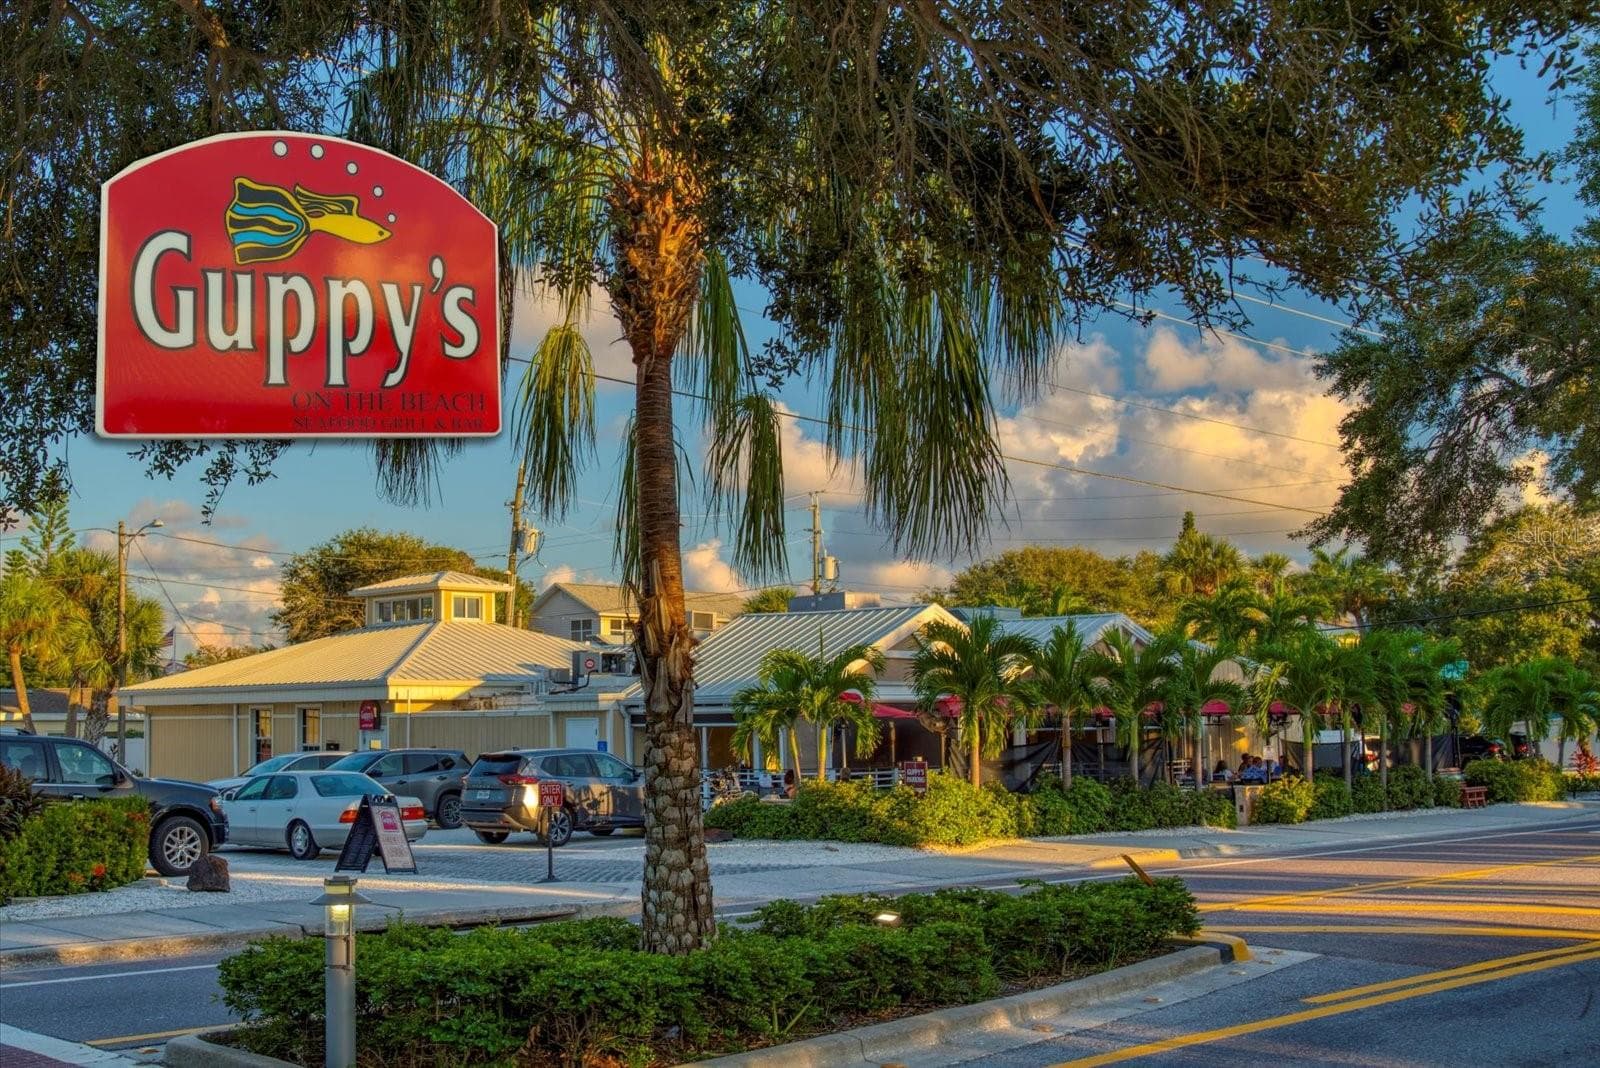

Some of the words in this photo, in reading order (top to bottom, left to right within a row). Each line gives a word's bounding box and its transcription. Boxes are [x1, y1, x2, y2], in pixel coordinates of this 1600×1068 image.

[131, 229, 481, 389] Guppy's
[292, 391, 332, 411] ON
[342, 391, 392, 411] THE
[401, 391, 486, 411] BEACH
[293, 415, 376, 431] SEAFOOD
[434, 416, 446, 431] &
[451, 415, 484, 431] BAR
[541, 784, 561, 795] ENTER
[543, 795, 560, 806] ONLY
